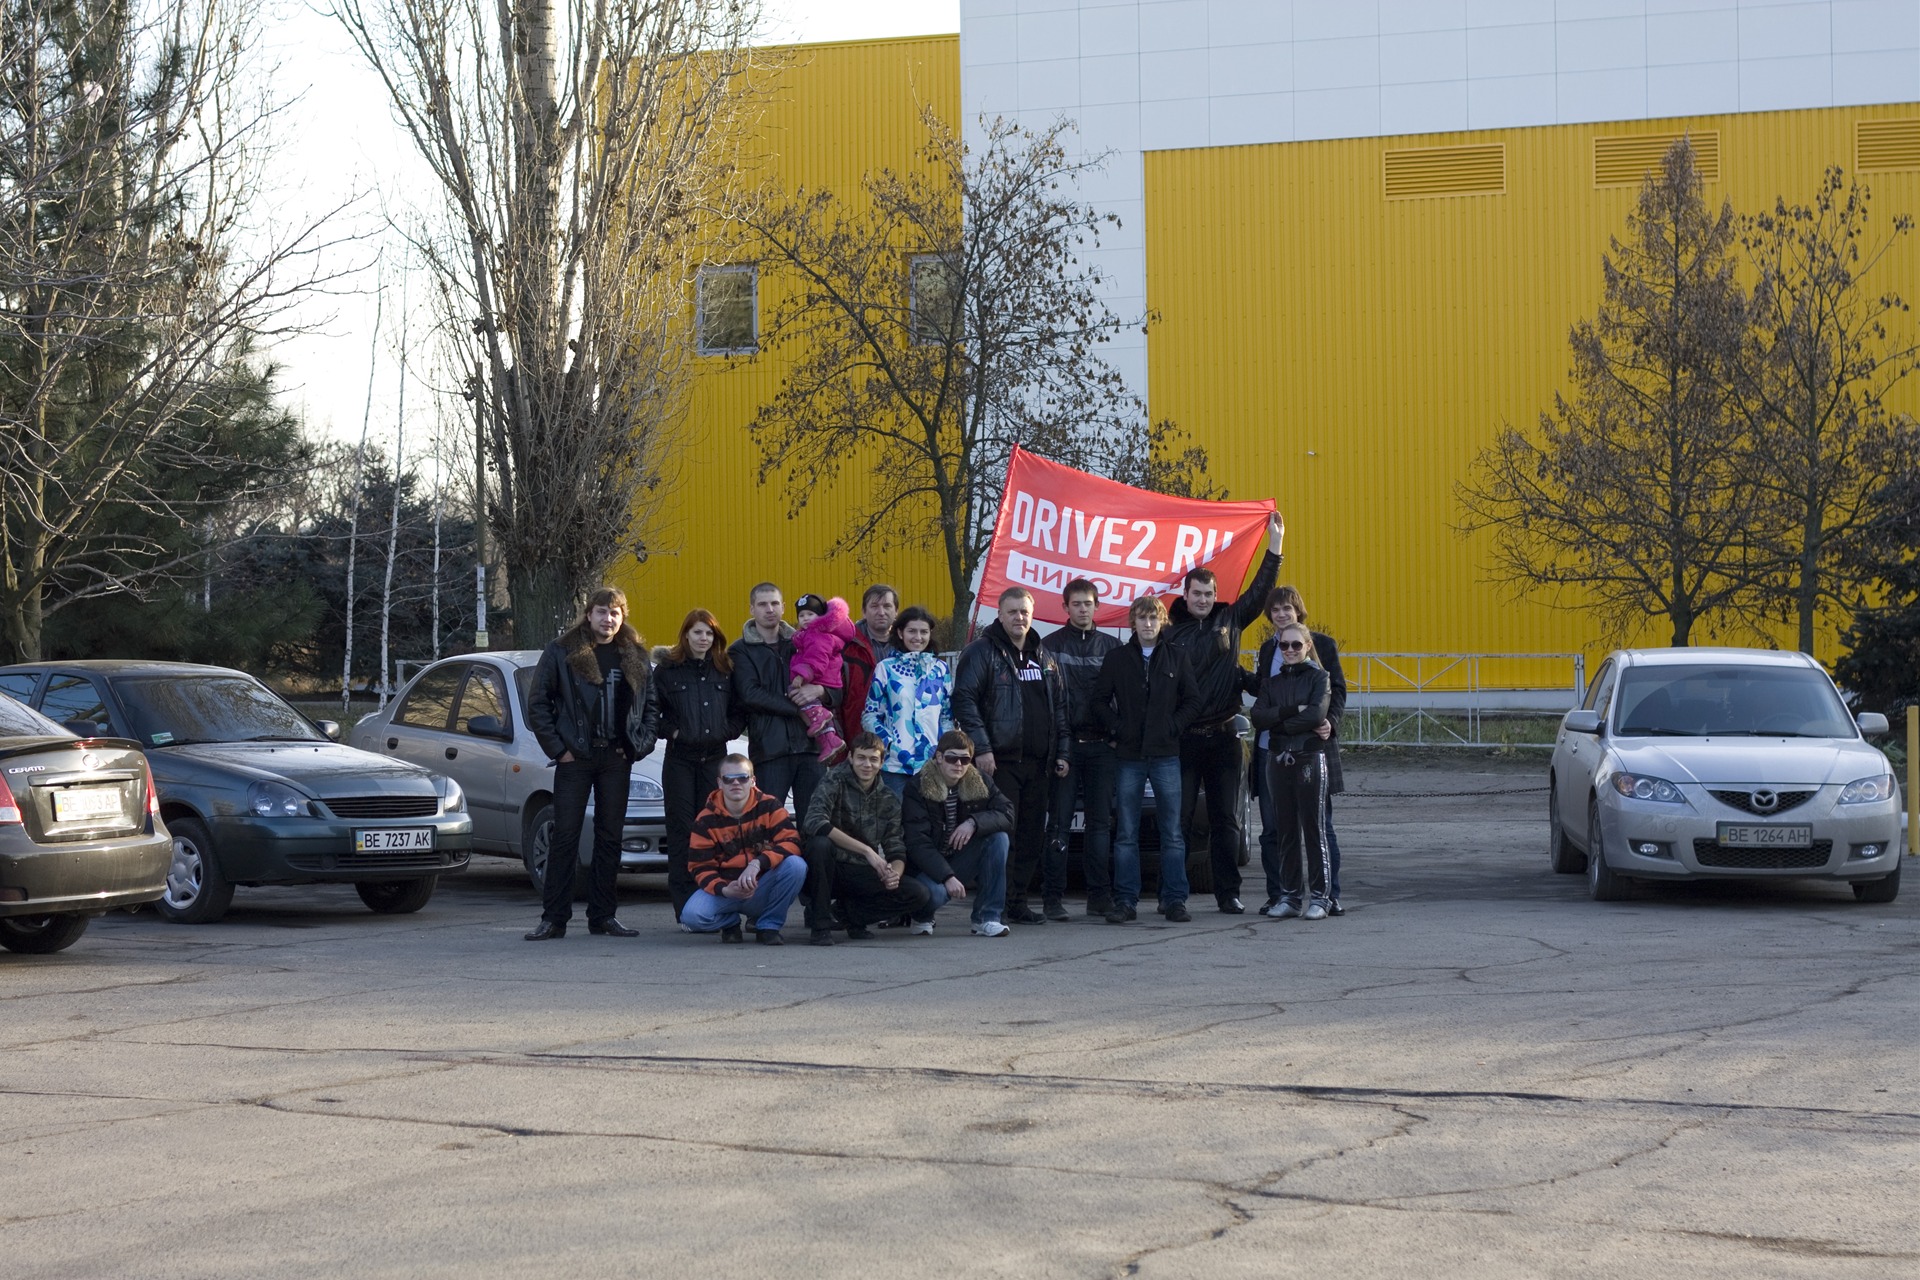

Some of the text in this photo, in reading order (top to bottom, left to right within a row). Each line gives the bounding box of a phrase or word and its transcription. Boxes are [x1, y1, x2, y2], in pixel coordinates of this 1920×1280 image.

[1011, 490, 1234, 574] DRIVE2.RU
[1018, 668, 1042, 681] UMA
[8, 765, 46, 774] CERATO
[61, 796, 78, 812] BE
[364, 833, 381, 848] BE
[385, 832, 411, 847] 7237
[414, 831, 430, 847] AK
[1728, 828, 1807, 843] BE 1264 AH
